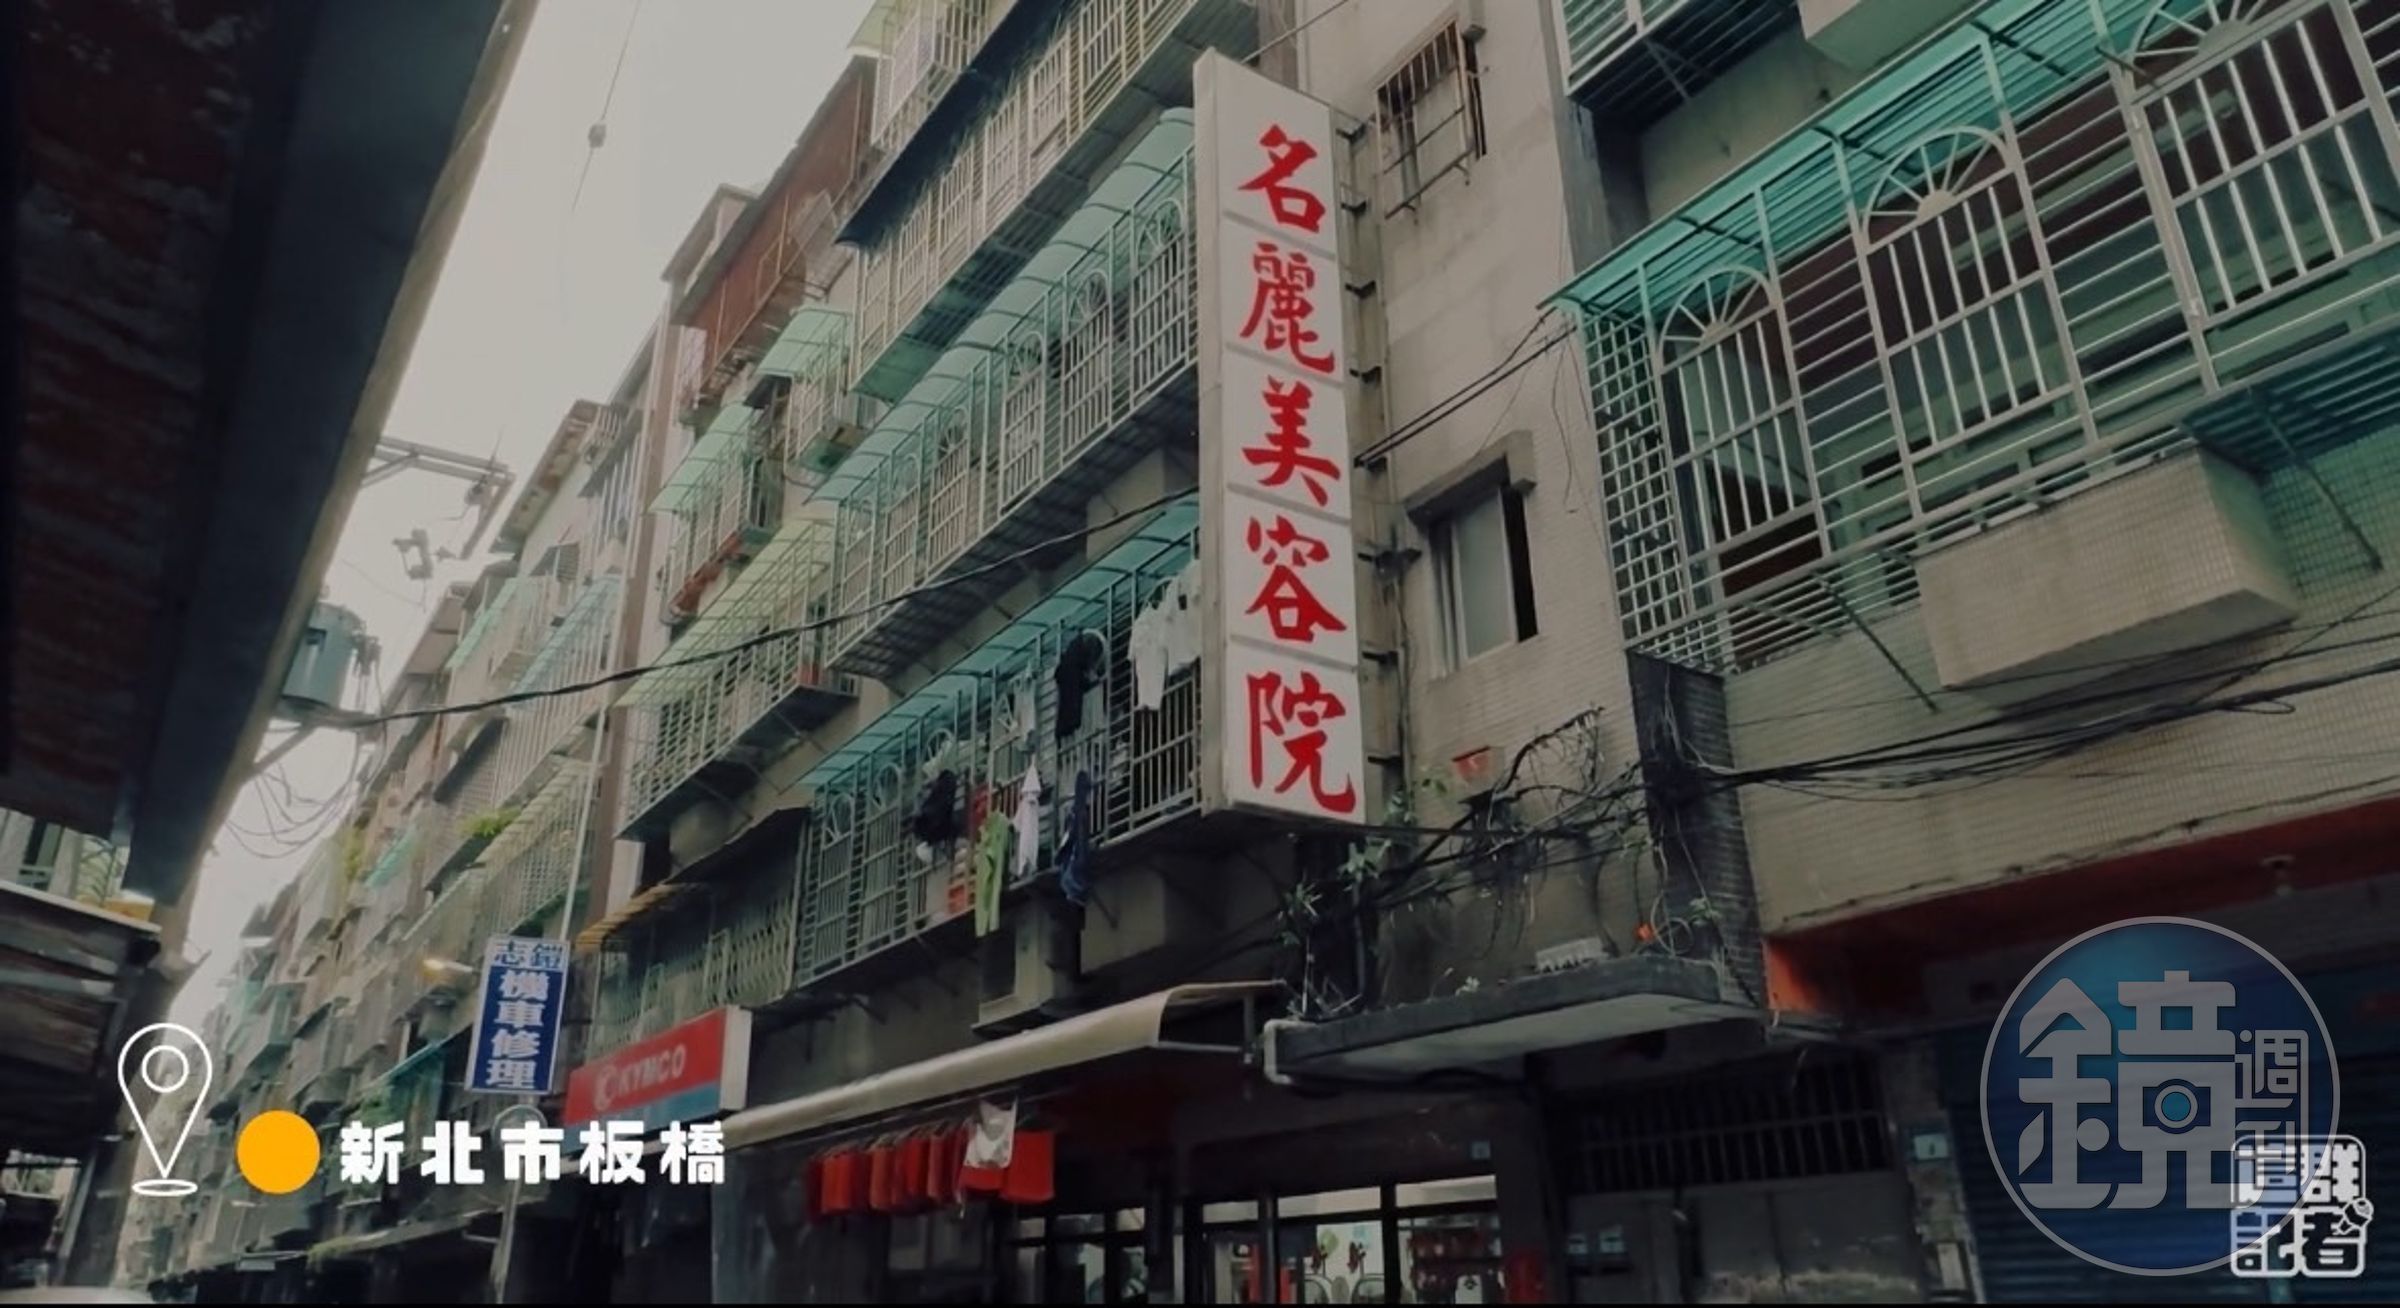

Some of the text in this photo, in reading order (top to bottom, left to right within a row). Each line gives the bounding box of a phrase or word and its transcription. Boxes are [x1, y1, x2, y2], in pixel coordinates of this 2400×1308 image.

[1237, 123, 1356, 814] 名麗美容院
[486, 968, 549, 1089] 機車修理
[618, 1043, 687, 1097] KYMCO
